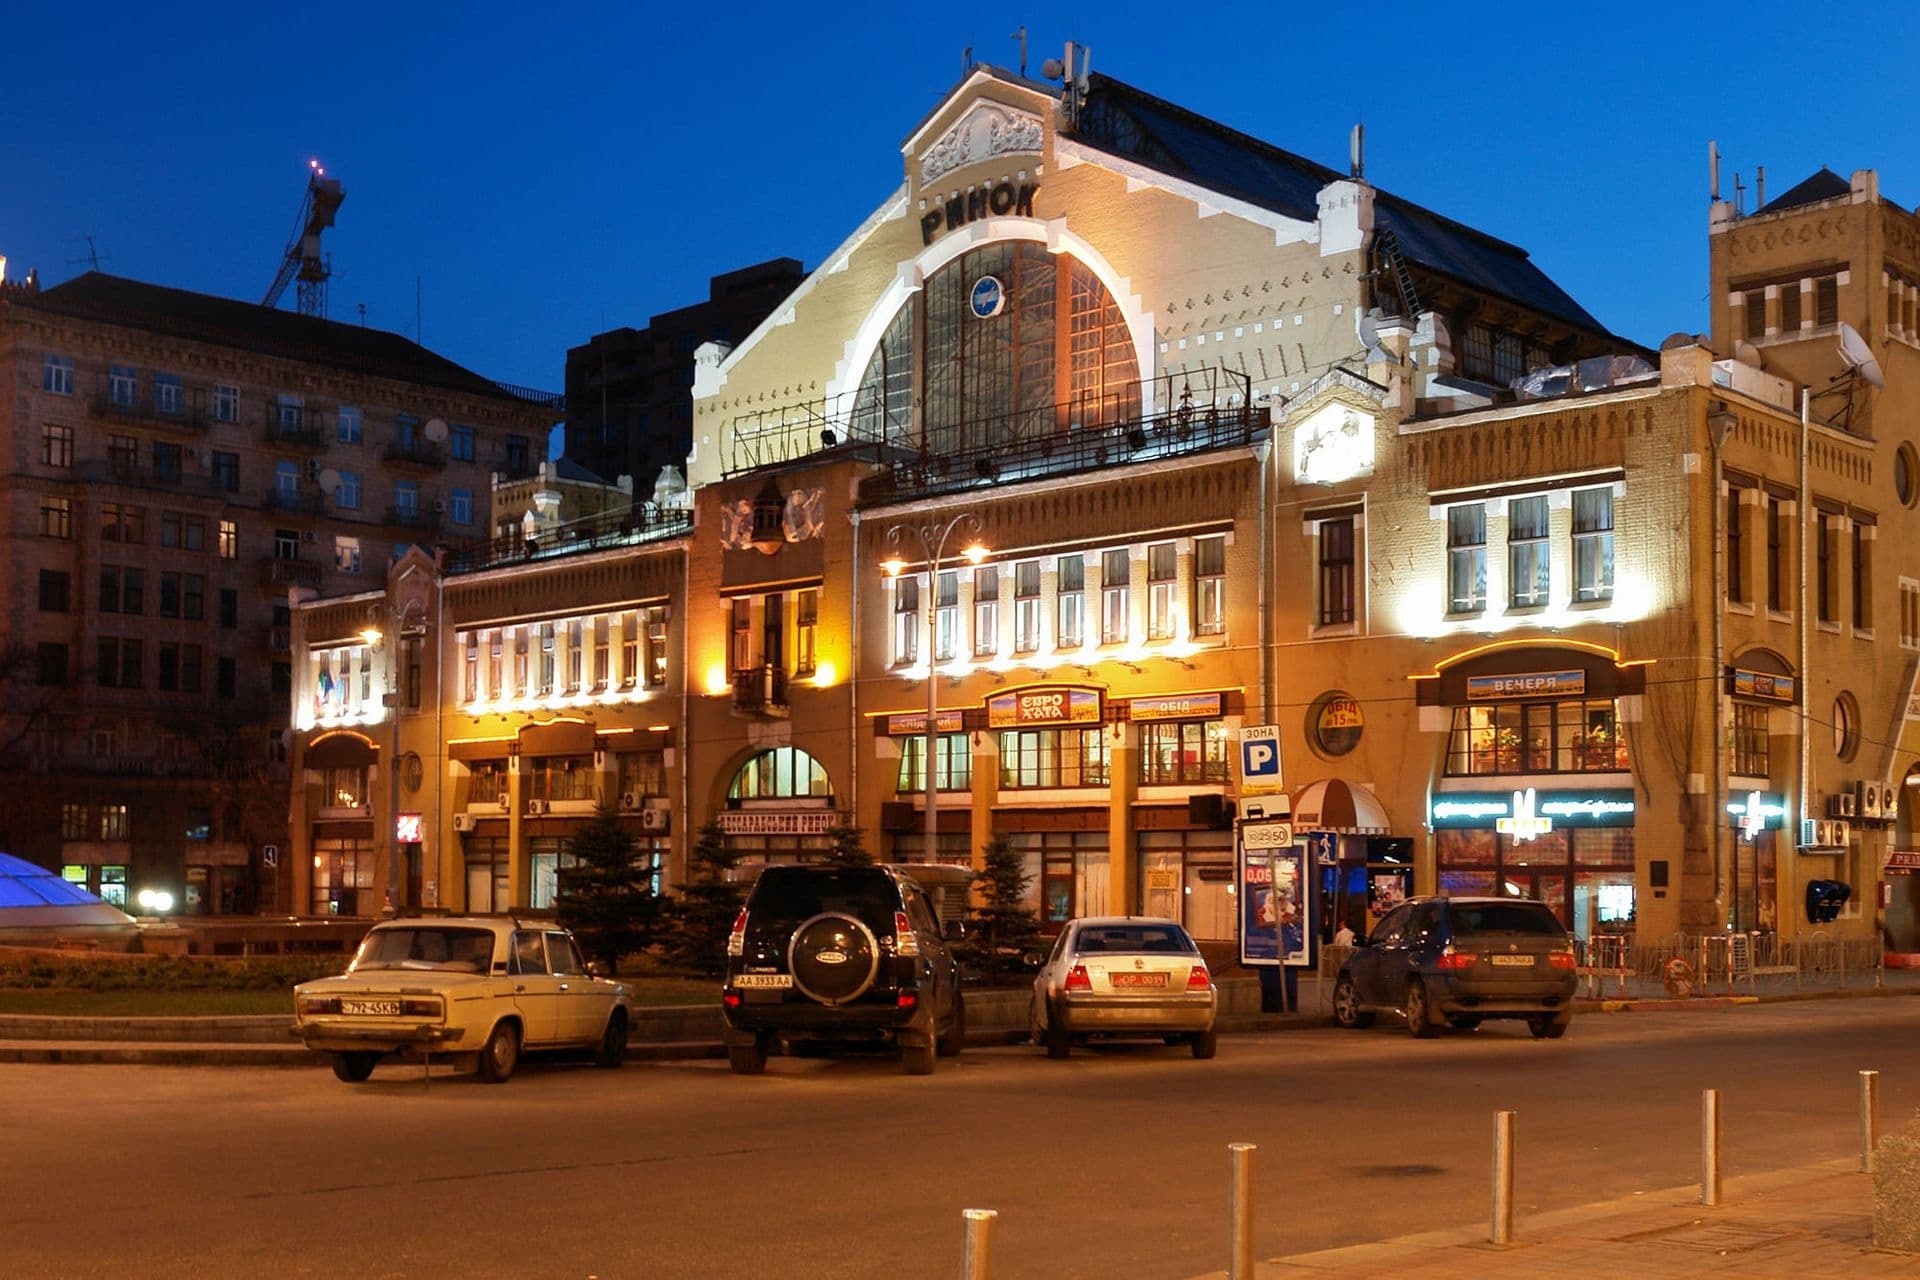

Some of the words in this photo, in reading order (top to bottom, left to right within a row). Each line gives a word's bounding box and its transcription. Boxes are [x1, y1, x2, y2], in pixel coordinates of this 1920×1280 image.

[920, 182, 1041, 246] РИНОК
[1494, 677, 1557, 691] ВЕЧЕРЯ
[1160, 701, 1190, 712] ОБІД
[1022, 705, 1064, 720] ХАТА
[1334, 714, 1346, 725] 15
[1246, 728, 1274, 738] ЗОНА
[1250, 745, 1272, 771] P
[1272, 831, 1285, 841] 50
[740, 976, 752, 985] AA
[754, 976, 775, 985] 3933
[777, 976, 790, 985] AA
